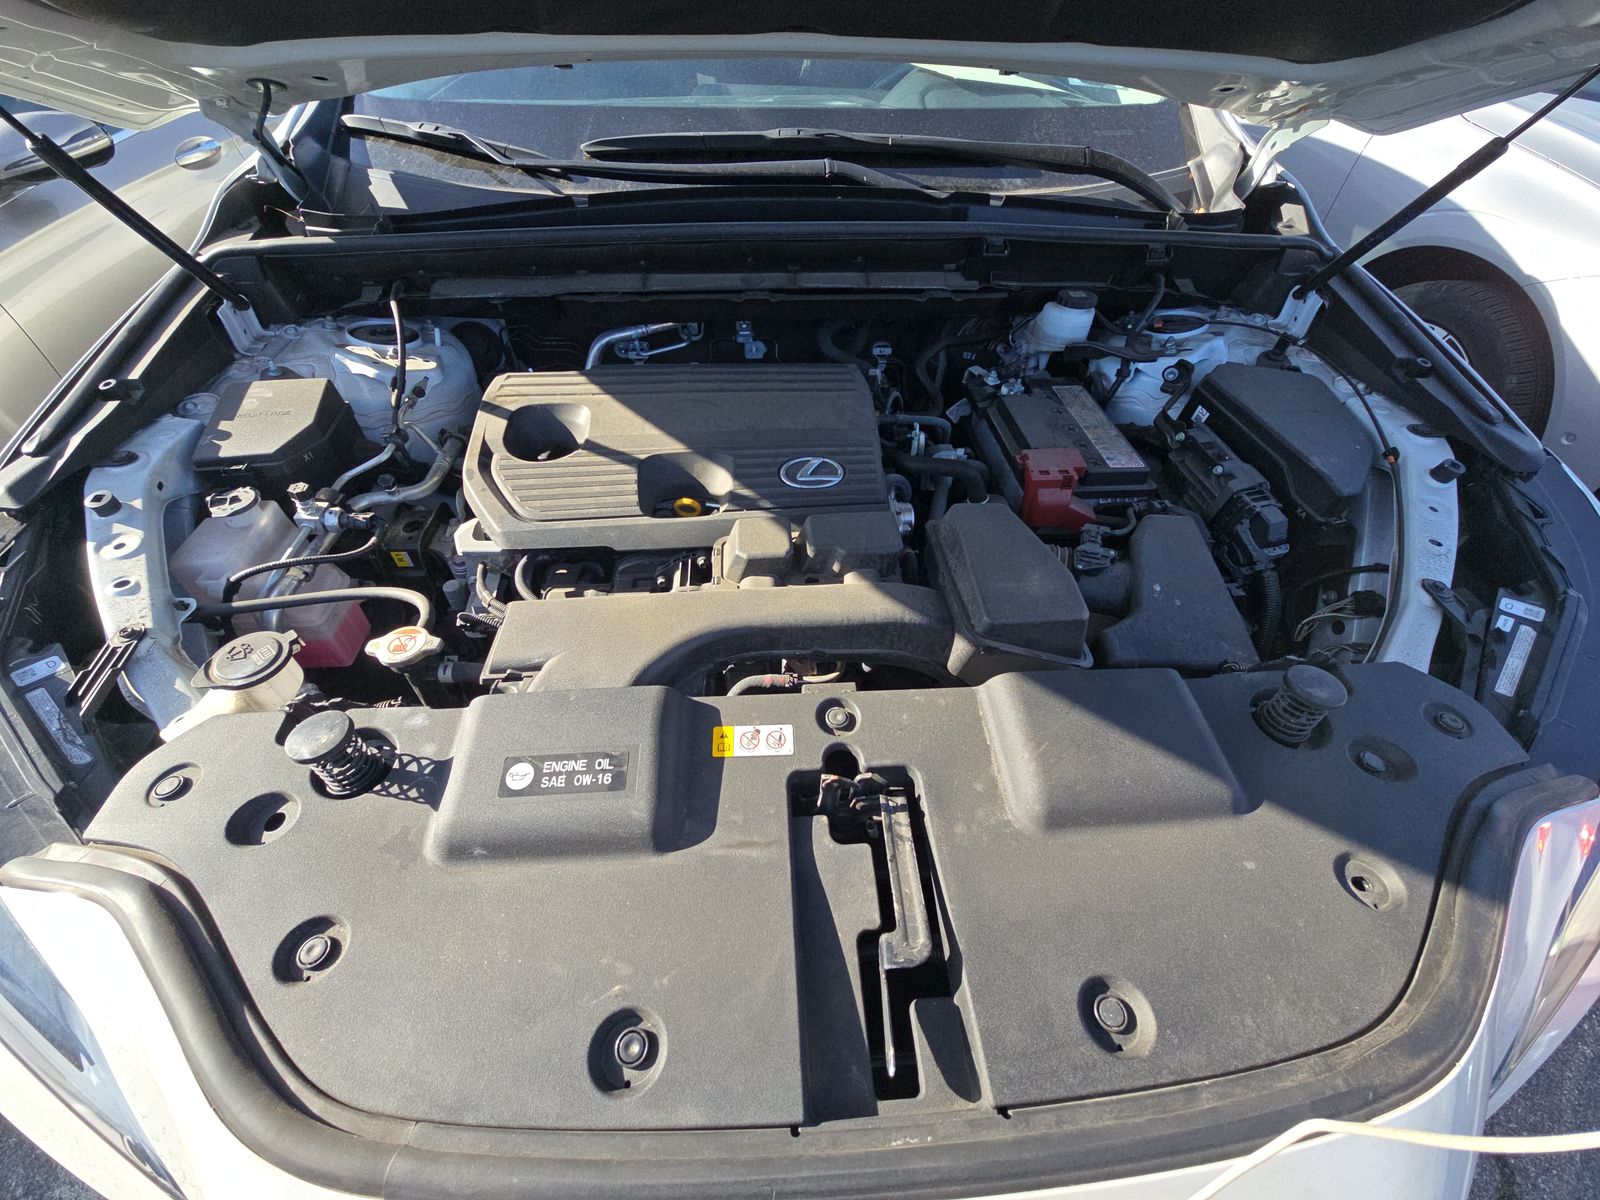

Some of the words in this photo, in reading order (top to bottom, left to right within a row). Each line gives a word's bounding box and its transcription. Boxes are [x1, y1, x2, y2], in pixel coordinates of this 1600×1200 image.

[542, 759, 588, 773] ENGINE
[594, 757, 614, 770] OIL
[540, 775, 567, 788] SAE
